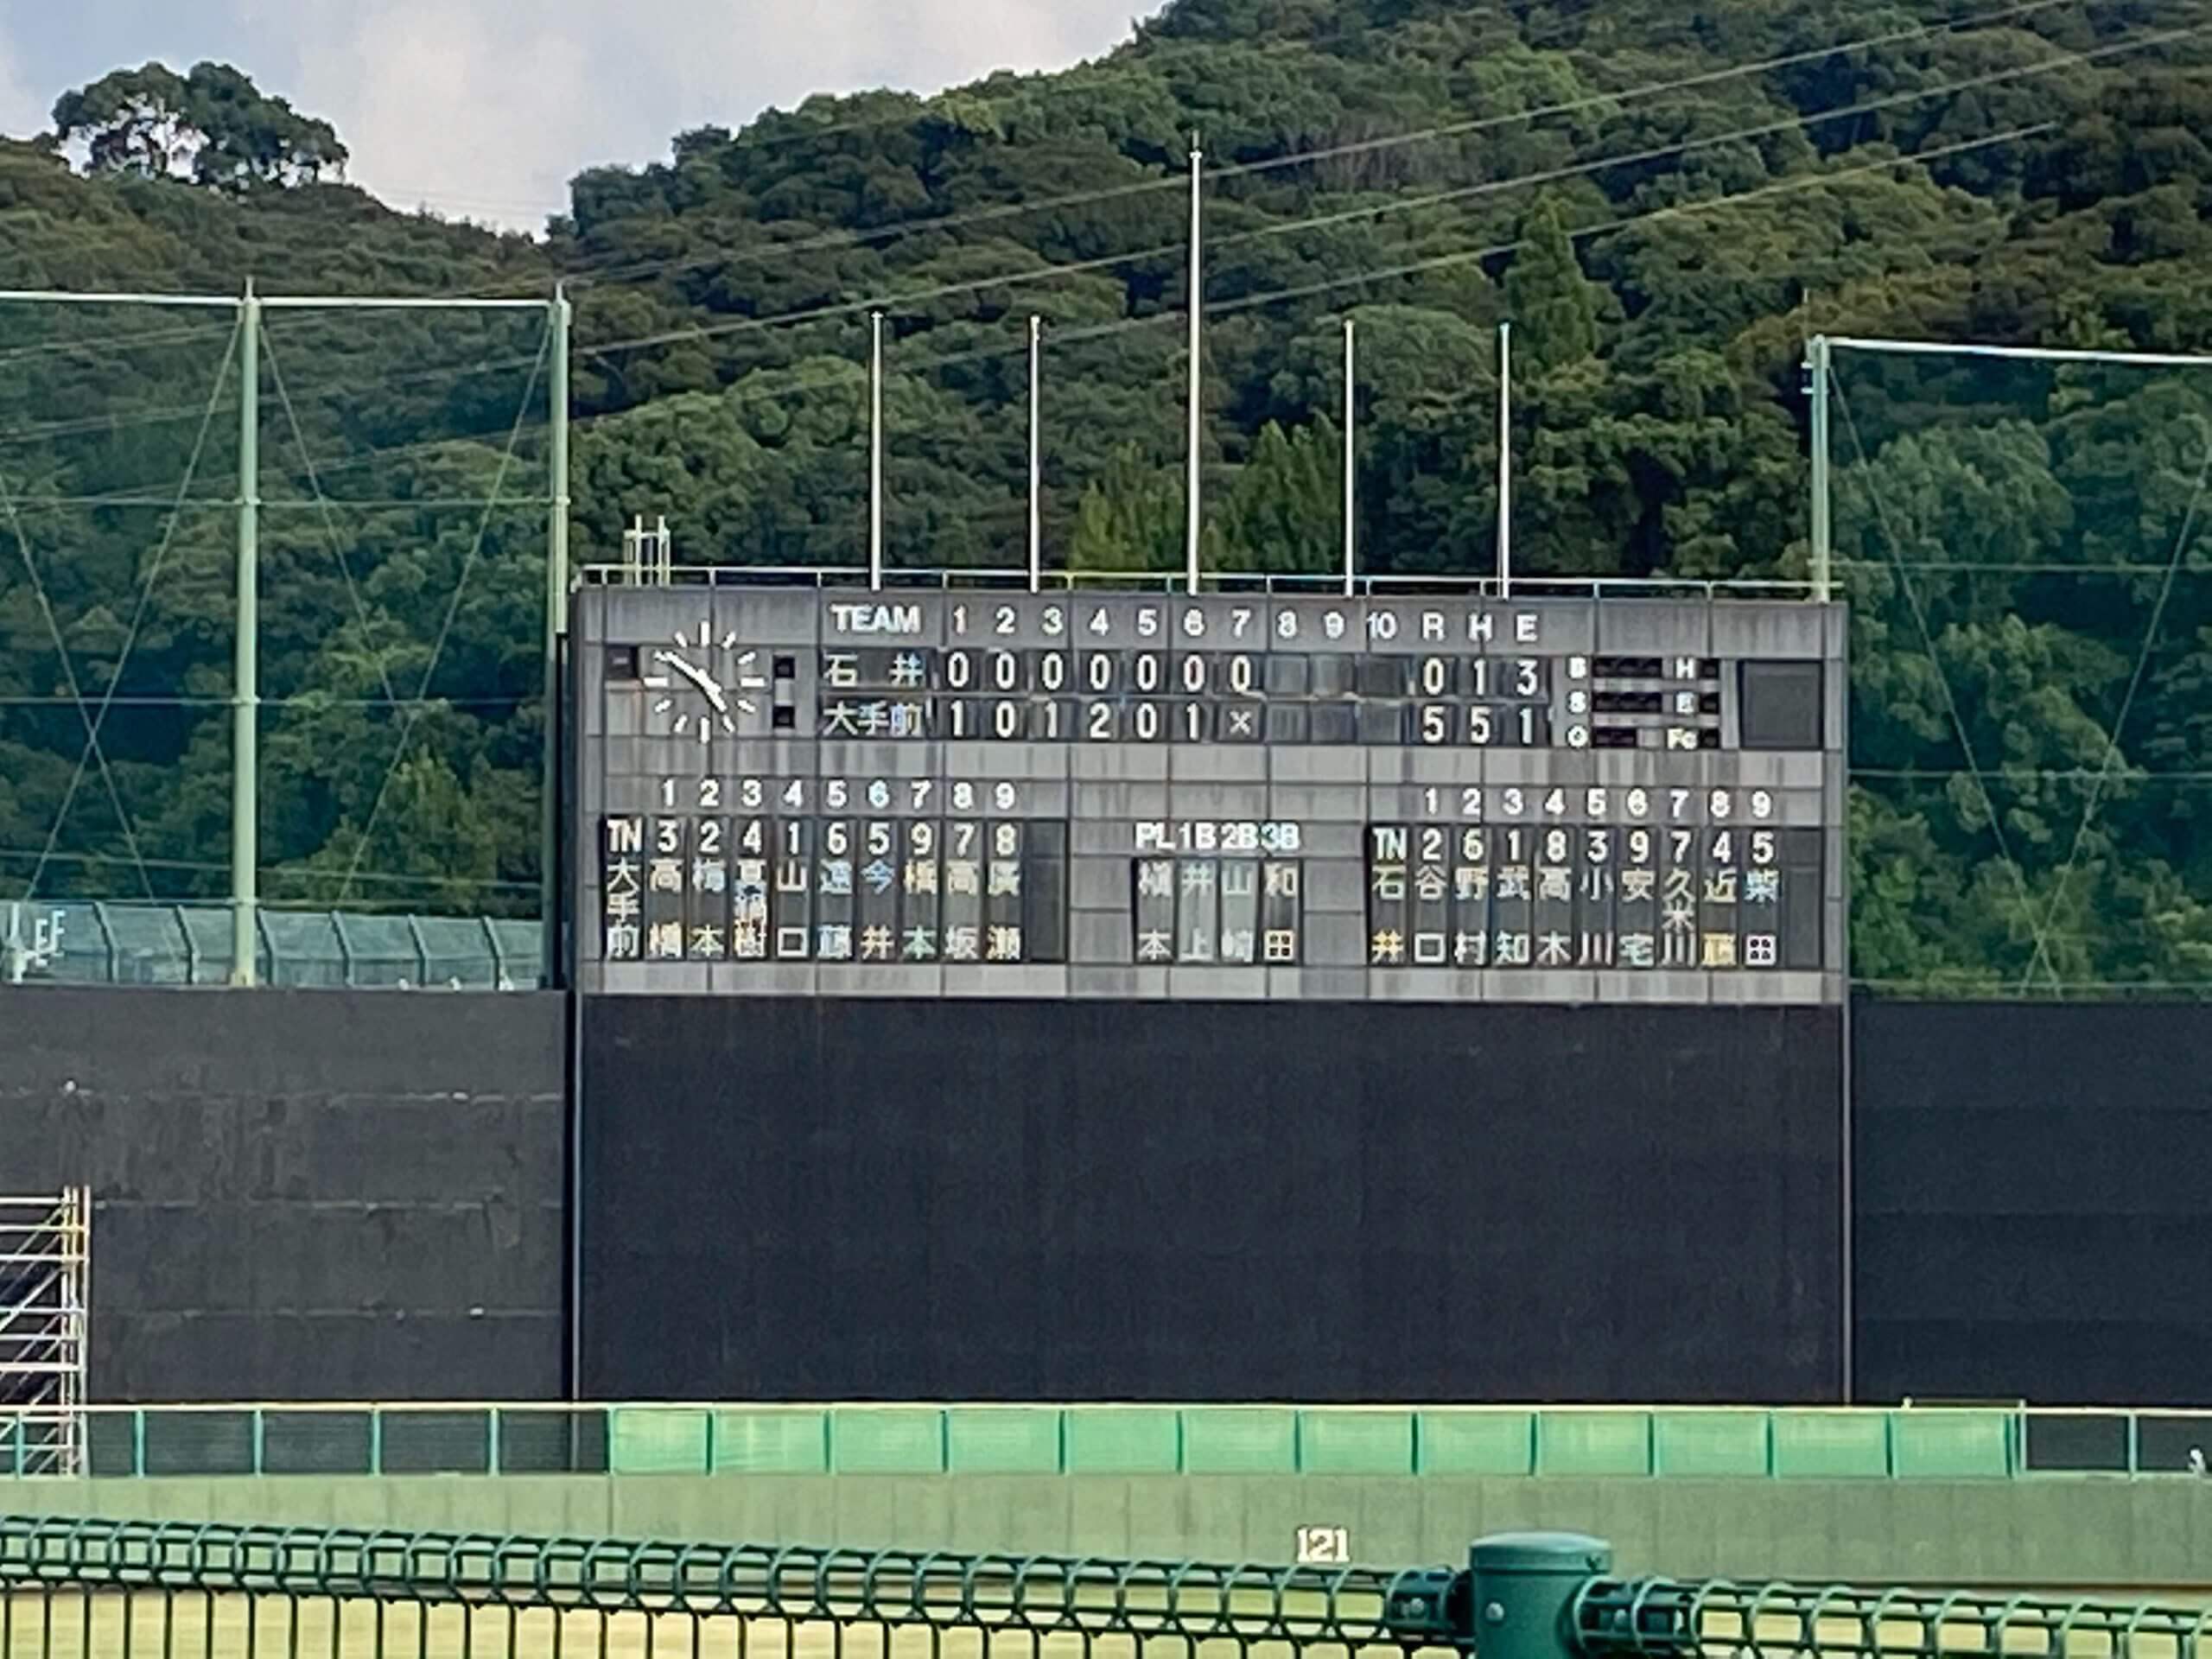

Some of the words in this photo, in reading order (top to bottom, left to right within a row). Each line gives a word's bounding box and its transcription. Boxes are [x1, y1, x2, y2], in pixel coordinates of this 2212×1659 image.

[830, 604, 920, 632] TEAM
[954, 606, 965, 634] 1
[996, 607, 1014, 633] 2
[1043, 607, 1063, 634] 3
[1090, 608, 1109, 636] 4
[1138, 609, 1157, 636] 5
[1184, 609, 1205, 636] 6
[1232, 610, 1250, 637] 7
[1278, 611, 1297, 638] 8
[1325, 612, 1344, 639] 9
[1366, 612, 1397, 639] 10
[1423, 613, 1445, 640] R
[1469, 613, 1492, 641] H
[1516, 614, 1537, 641] E
[823, 653, 924, 688] 石井
[948, 652, 969, 687] 0
[996, 652, 1015, 690] 0
[1042, 652, 1063, 690] 0
[1090, 654, 1110, 690] 0
[1137, 654, 1157, 690] 0
[1184, 655, 1205, 692] 0
[1231, 655, 1250, 692] 0
[1424, 658, 1444, 695] 0
[1474, 659, 1485, 695] 1
[1517, 659, 1537, 696] 3
[1676, 658, 1694, 678] H
[823, 701, 923, 737] 大手前
[950, 700, 963, 736] 1
[996, 701, 1015, 738] 0
[1045, 701, 1058, 738] 1
[1090, 702, 1110, 738] 2
[1137, 702, 1157, 739] 0
[1186, 703, 1198, 740] 1
[1423, 706, 1444, 742] 5
[1471, 706, 1491, 743] 5
[1520, 708, 1532, 744] 1
[664, 779, 674, 806] 1
[700, 779, 719, 806] 2
[741, 779, 762, 807] 3
[784, 779, 803, 807] 4
[827, 780, 847, 807] 5
[868, 780, 889, 809] 6
[912, 780, 931, 809] 7
[953, 782, 974, 810] 8
[995, 783, 1015, 810] 9
[1426, 787, 1437, 815] 1
[1463, 788, 1481, 816] 2
[1503, 788, 1523, 816] 3
[1545, 788, 1565, 816] 4
[1587, 788, 1606, 817] 5
[1627, 789, 1648, 817] 6
[1670, 790, 1689, 817] 7
[1710, 791, 1731, 818] 8
[1752, 791, 1770, 818] 9
[658, 820, 678, 852] 3
[700, 821, 721, 853] 2
[743, 820, 761, 854] 4
[789, 822, 799, 855] 1
[828, 822, 847, 855] 6
[868, 822, 889, 855] 5
[912, 823, 931, 855] 9
[954, 823, 975, 855] 7
[996, 823, 1016, 856] 8
[1135, 822, 1176, 850] PL
[1179, 822, 1217, 851] 1B
[1221, 823, 1259, 851] 2B
[1261, 823, 1300, 851] 3B
[1422, 828, 1442, 861] 2
[1463, 829, 1484, 861] 6
[1508, 830, 1520, 861] 1
[1547, 830, 1566, 862] 8
[1587, 830, 1608, 862] 3
[1630, 830, 1649, 863] 9
[1671, 830, 1691, 863] 7
[1713, 831, 1731, 863] 4
[1752, 831, 1774, 864] 5
[606, 856, 640, 960] 大手前
[777, 860, 809, 957] 山口
[860, 859, 895, 959] 今井
[1264, 862, 1299, 961] 和田
[1371, 865, 1407, 963] 石井
[1414, 865, 1447, 963] 谷口
[1454, 865, 1489, 965] 野村
[1579, 867, 1614, 965] 小川
[1662, 867, 1696, 966] 久米川
[1745, 868, 1778, 965] 柴田
[1297, 1529, 1350, 1563] 121
